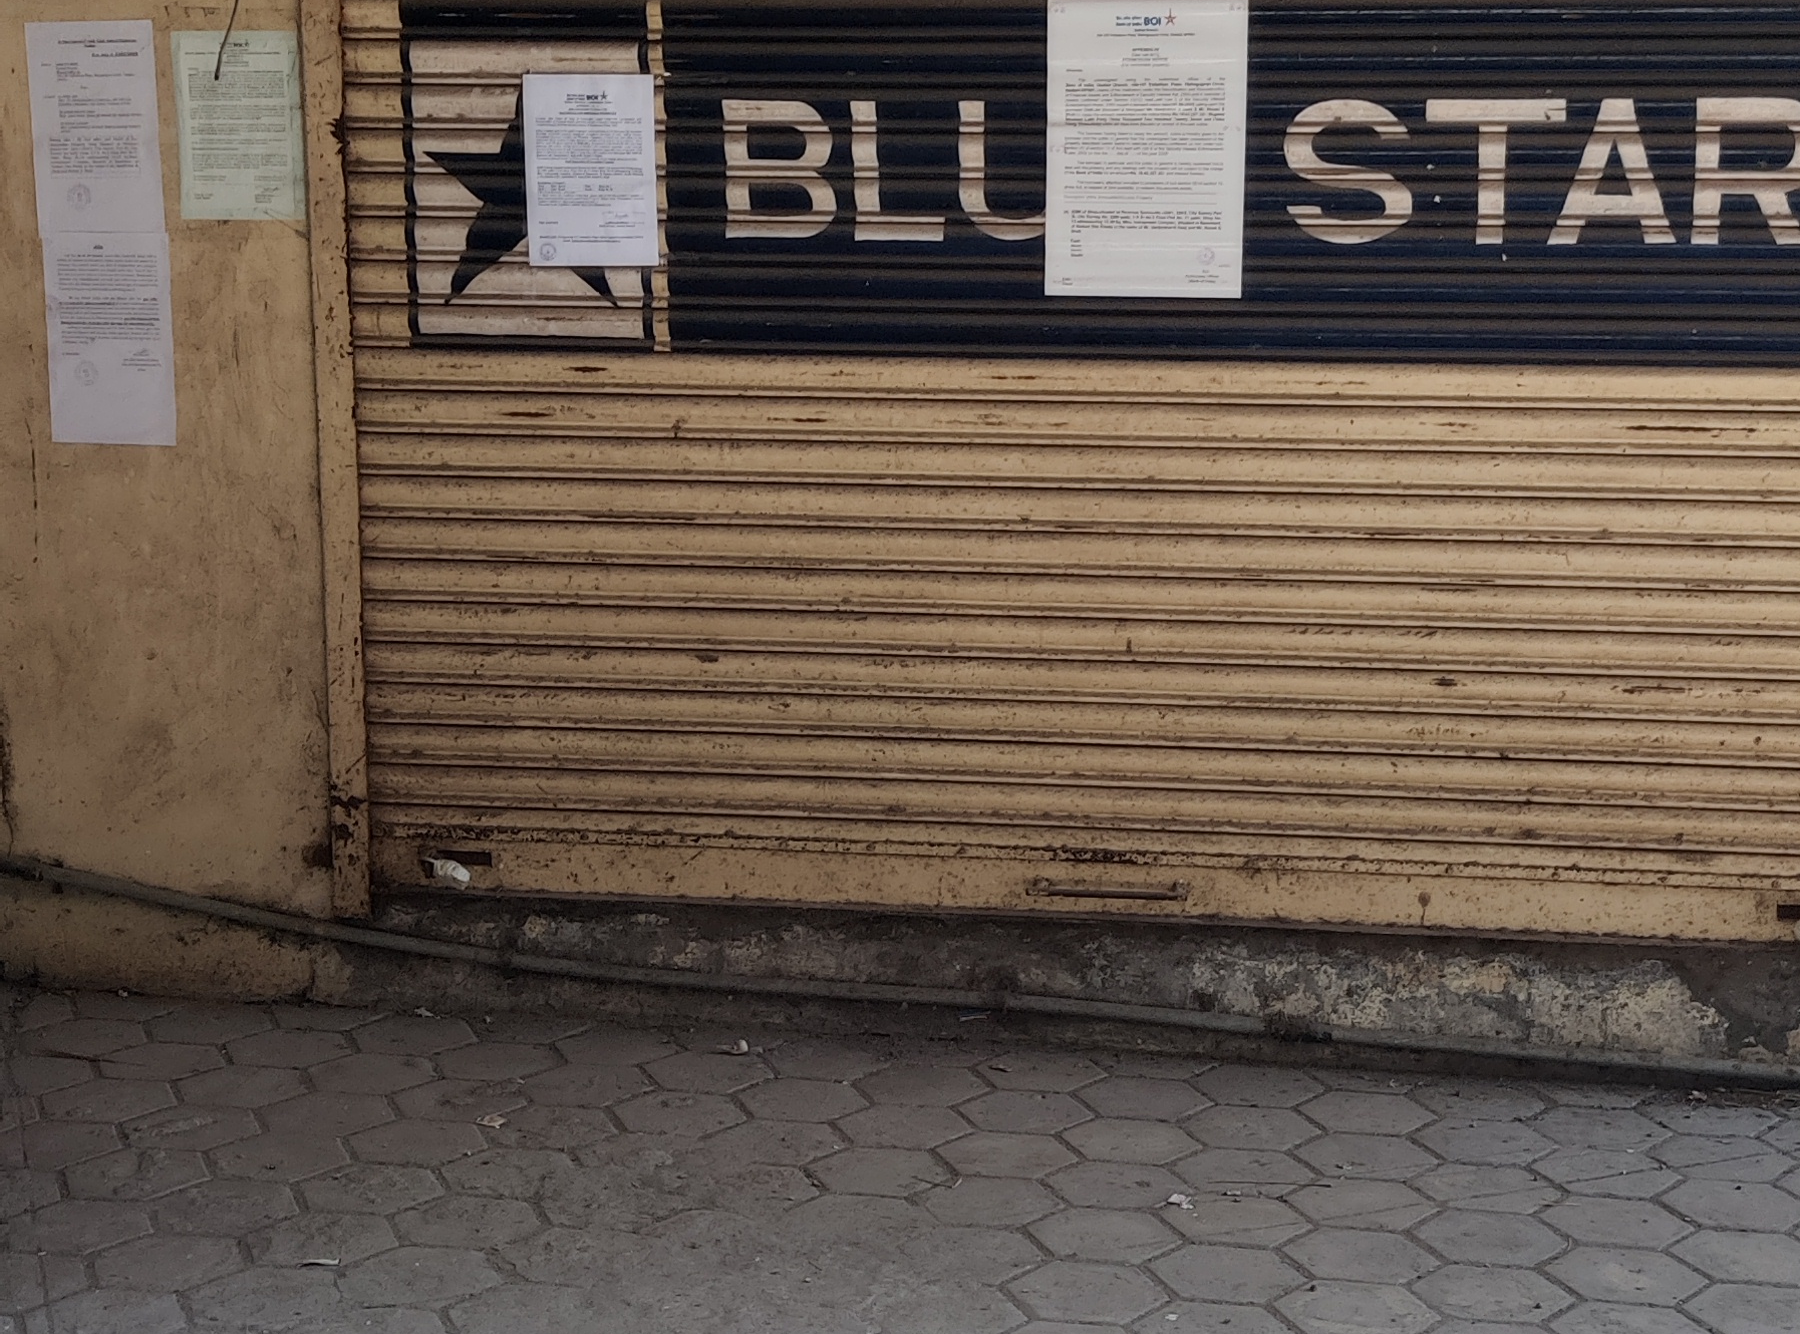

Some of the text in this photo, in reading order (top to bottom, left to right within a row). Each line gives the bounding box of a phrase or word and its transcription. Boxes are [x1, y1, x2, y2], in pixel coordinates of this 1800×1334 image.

[1143, 16, 1162, 27] BOI
[721, 97, 1800, 247] BLU STAR
